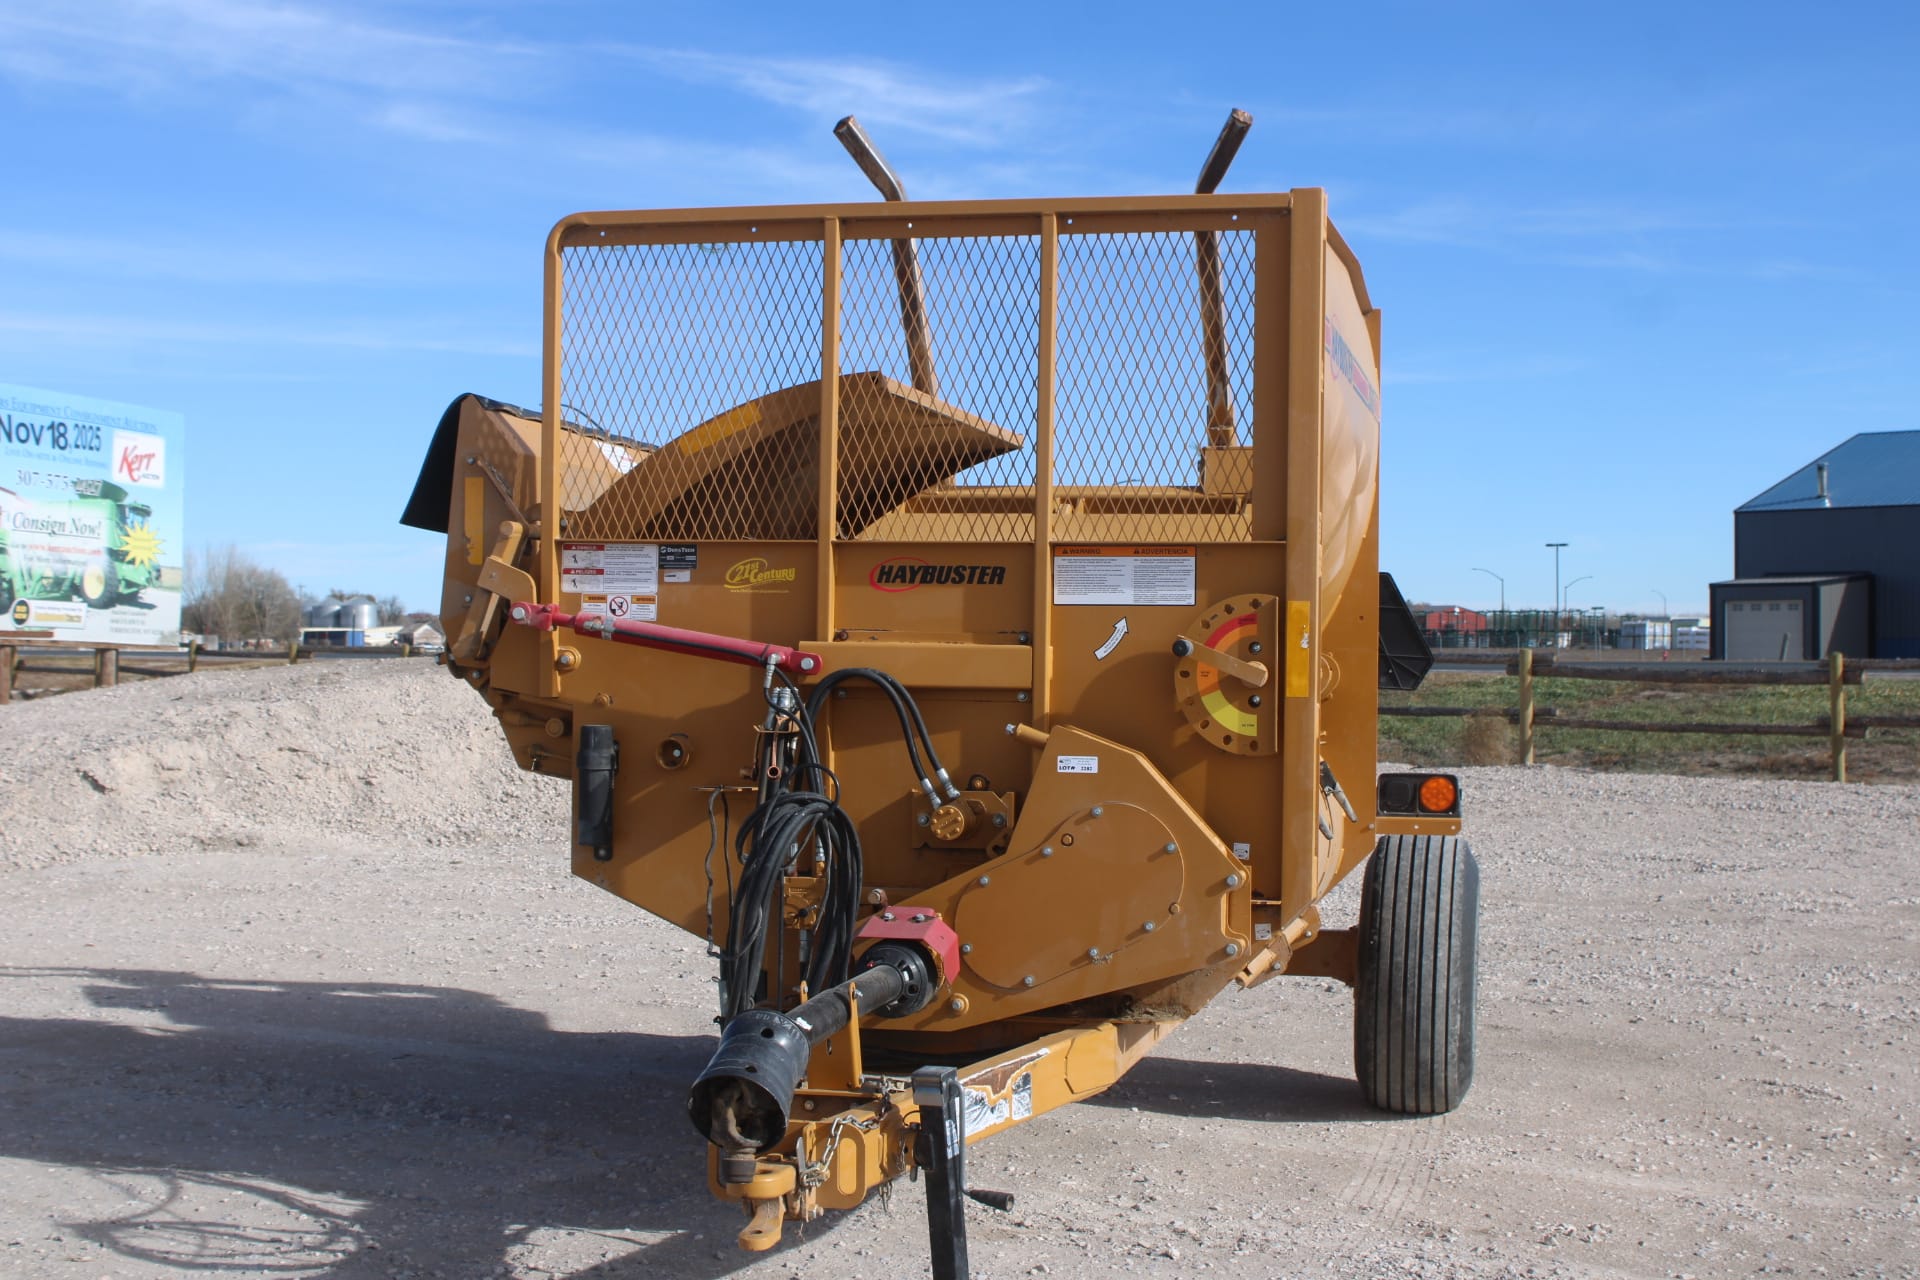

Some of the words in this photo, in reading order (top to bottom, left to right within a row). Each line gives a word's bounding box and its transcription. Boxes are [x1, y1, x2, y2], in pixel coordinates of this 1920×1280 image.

[74, 423, 102, 452] 2025
[118, 445, 156, 482] Kerr
[13, 511, 66, 537] Consign
[69, 517, 102, 537] Now!
[876, 564, 1006, 585] HAYBUSTER
